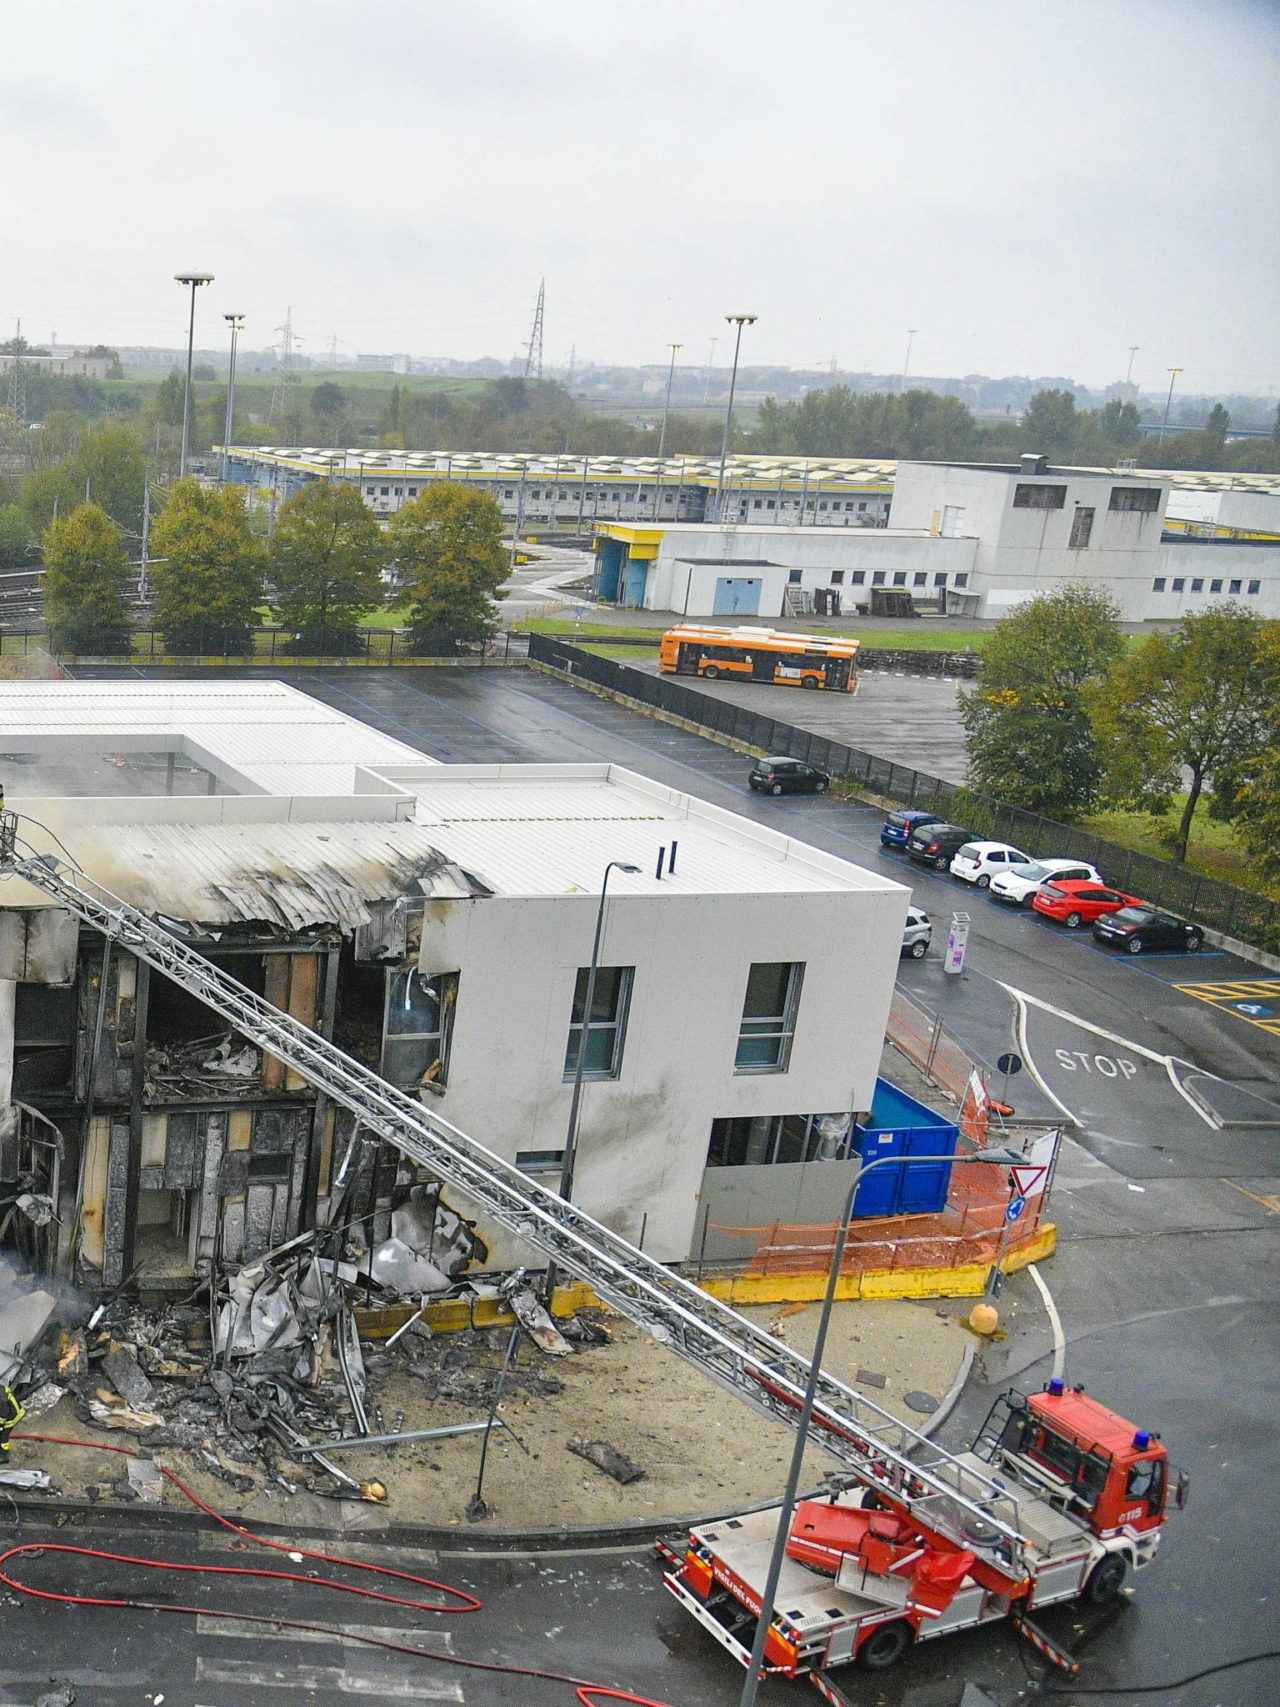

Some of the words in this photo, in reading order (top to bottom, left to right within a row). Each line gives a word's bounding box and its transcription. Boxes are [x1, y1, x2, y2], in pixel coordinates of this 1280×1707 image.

[1055, 1049, 1136, 1079] STOP
[713, 1566, 733, 1589] VIGILI
[732, 1584, 746, 1601] DEL
[745, 1596, 762, 1616] FUO
